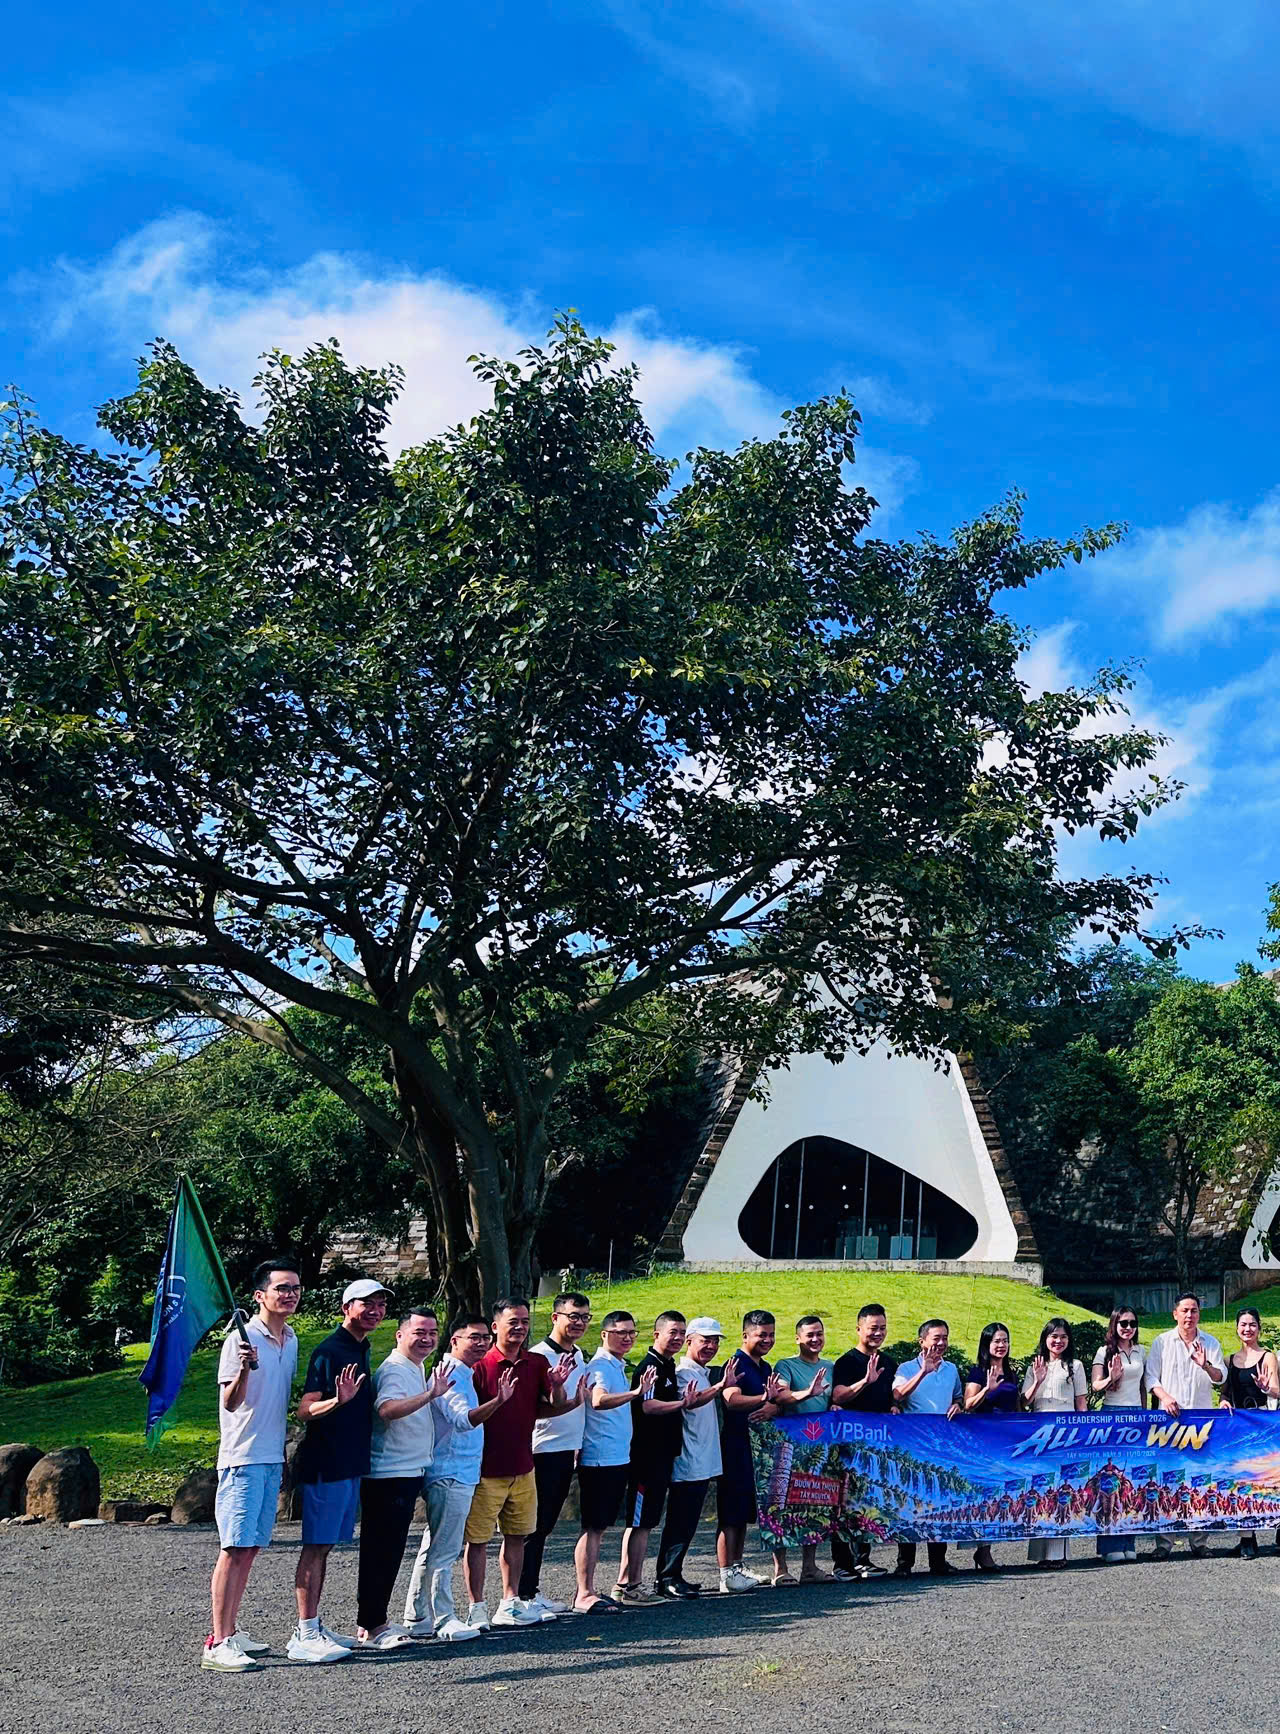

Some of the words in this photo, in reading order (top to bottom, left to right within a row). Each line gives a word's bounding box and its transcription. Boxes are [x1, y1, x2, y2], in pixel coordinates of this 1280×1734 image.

[1055, 1416, 1066, 1425] R5
[1068, 1415, 1113, 1424] LEADERSHIP
[1115, 1414, 1146, 1423] RETREAT
[1148, 1413, 1167, 1422] 2026
[1011, 1424, 1081, 1457] ALL
[1084, 1425, 1113, 1446] IN
[1116, 1426, 1142, 1445] TO
[1146, 1419, 1214, 1451] WIN
